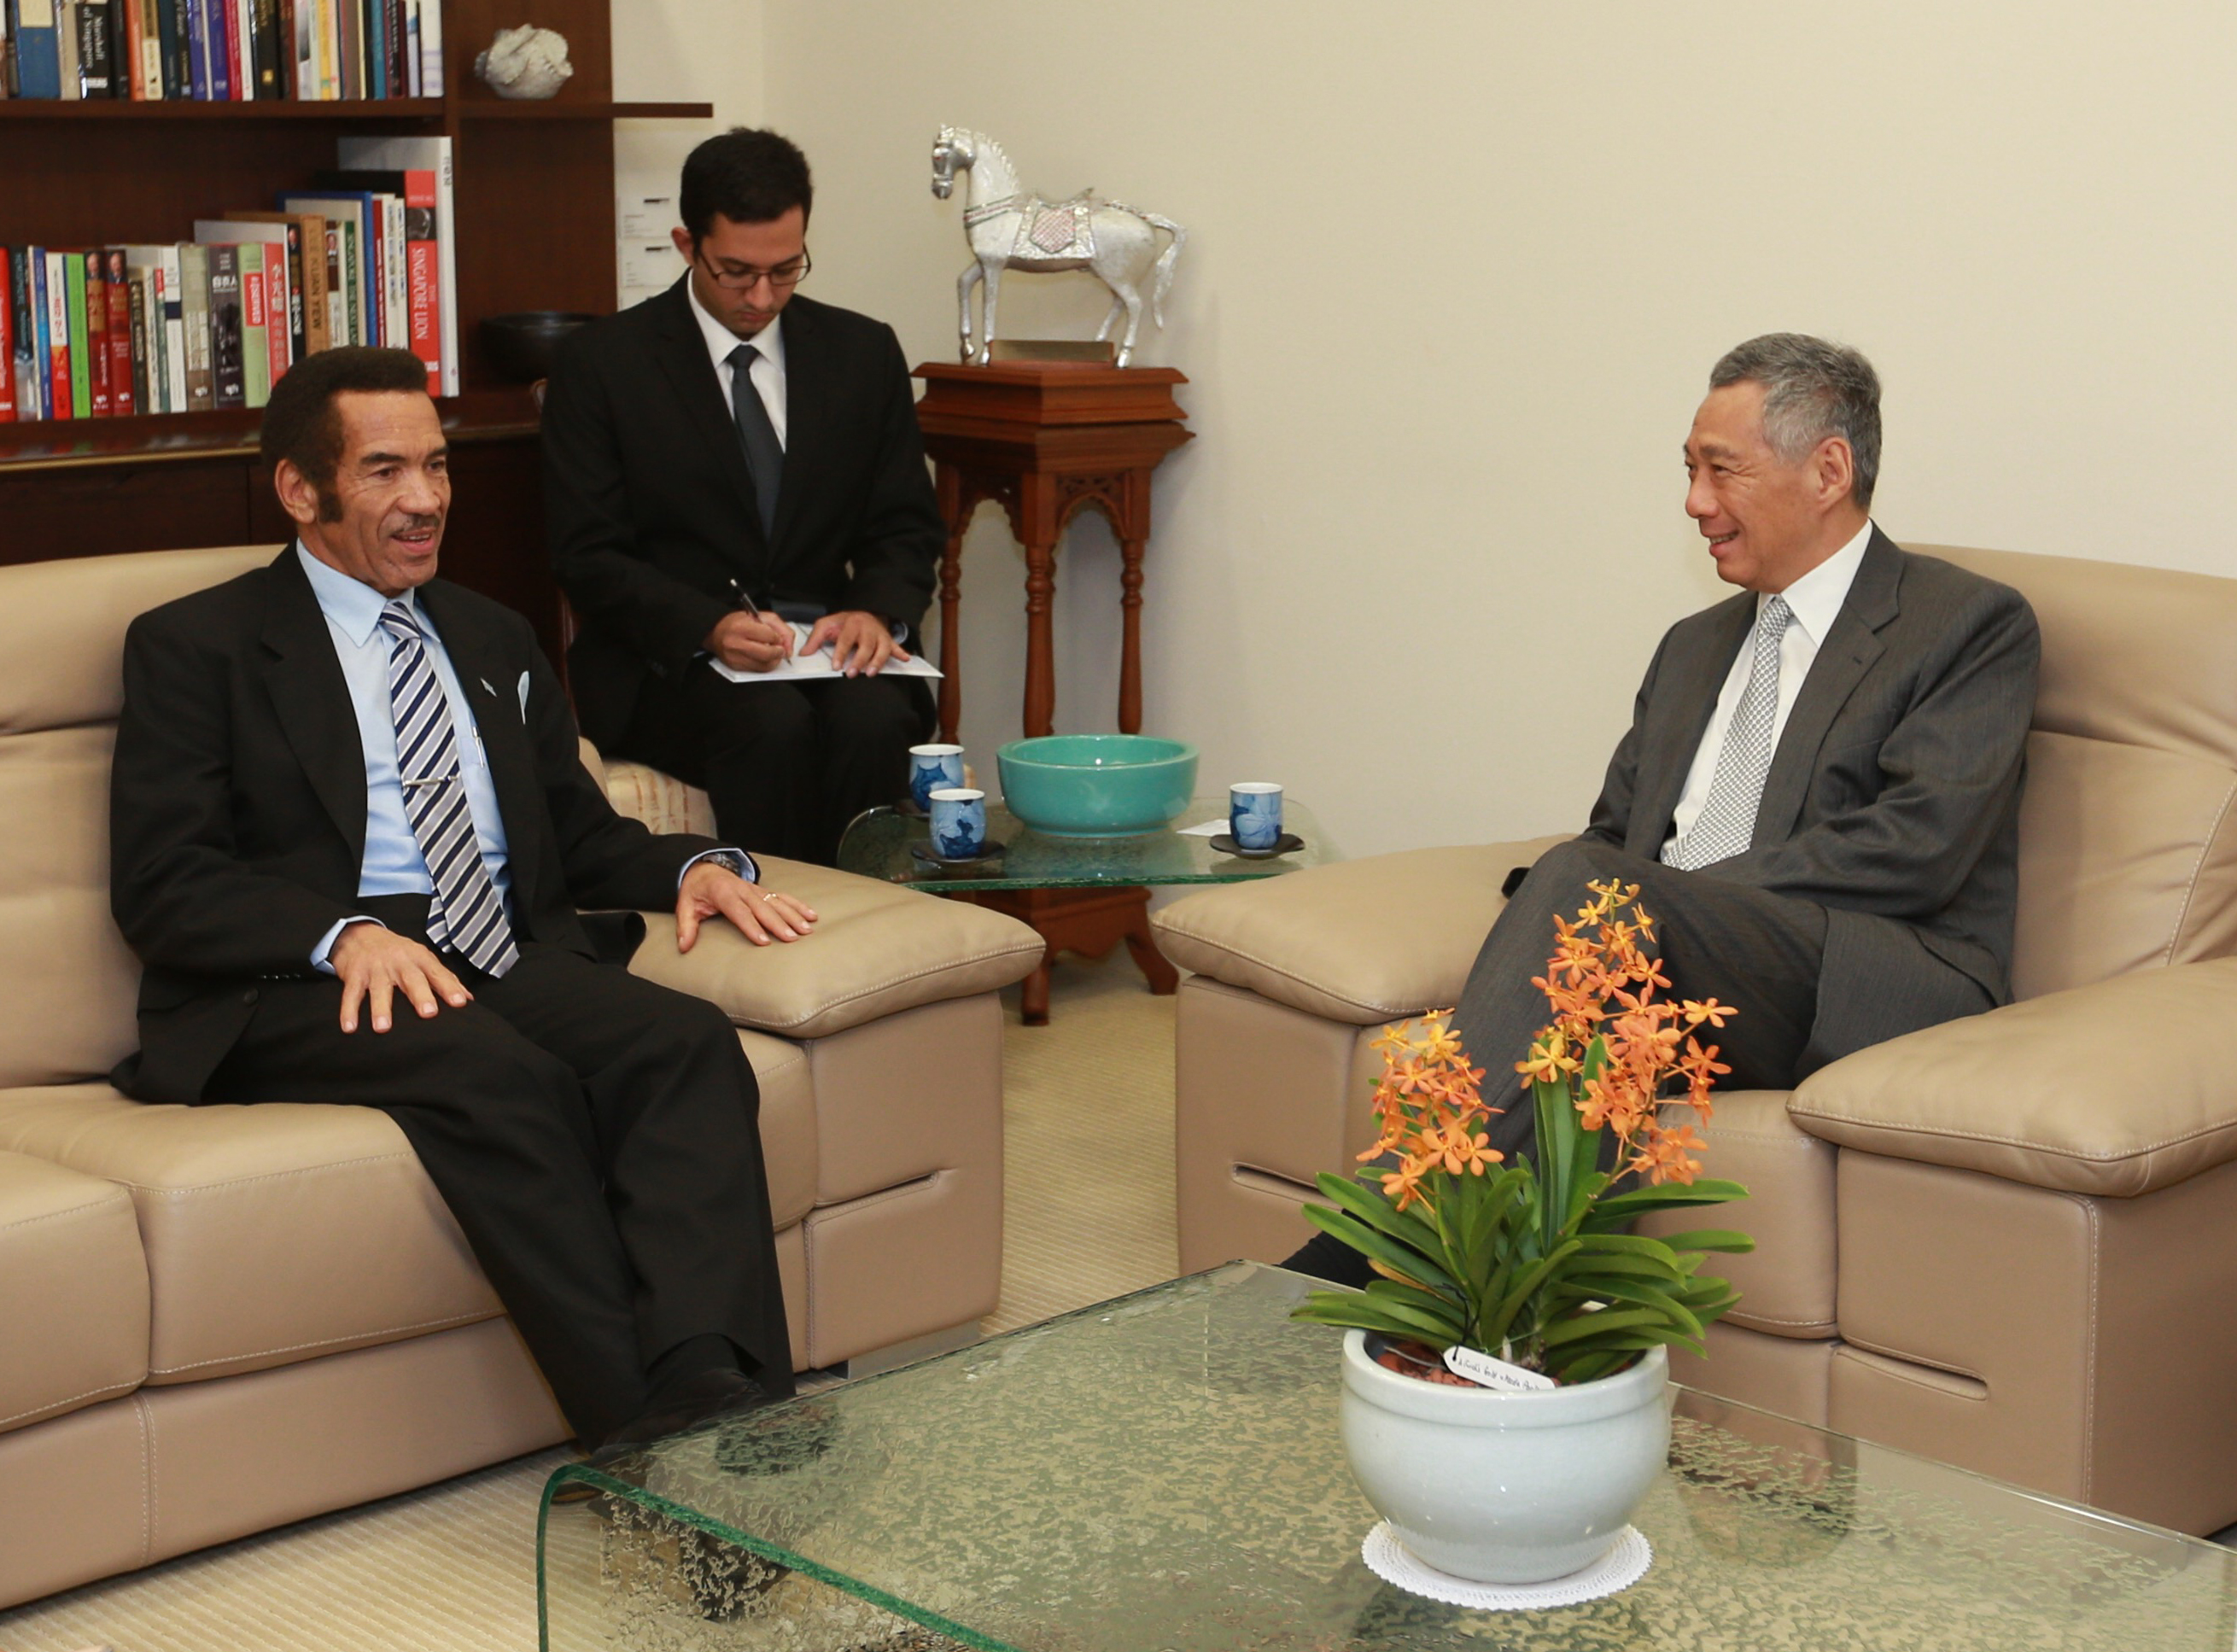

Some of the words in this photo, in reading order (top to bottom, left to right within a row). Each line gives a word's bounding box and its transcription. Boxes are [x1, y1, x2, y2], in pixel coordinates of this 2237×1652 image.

[83, 20, 94, 69] Singapore
[412, 248, 428, 310] SINGAPORE
[312, 299, 323, 330] YEW
[413, 312, 429, 340] LION
